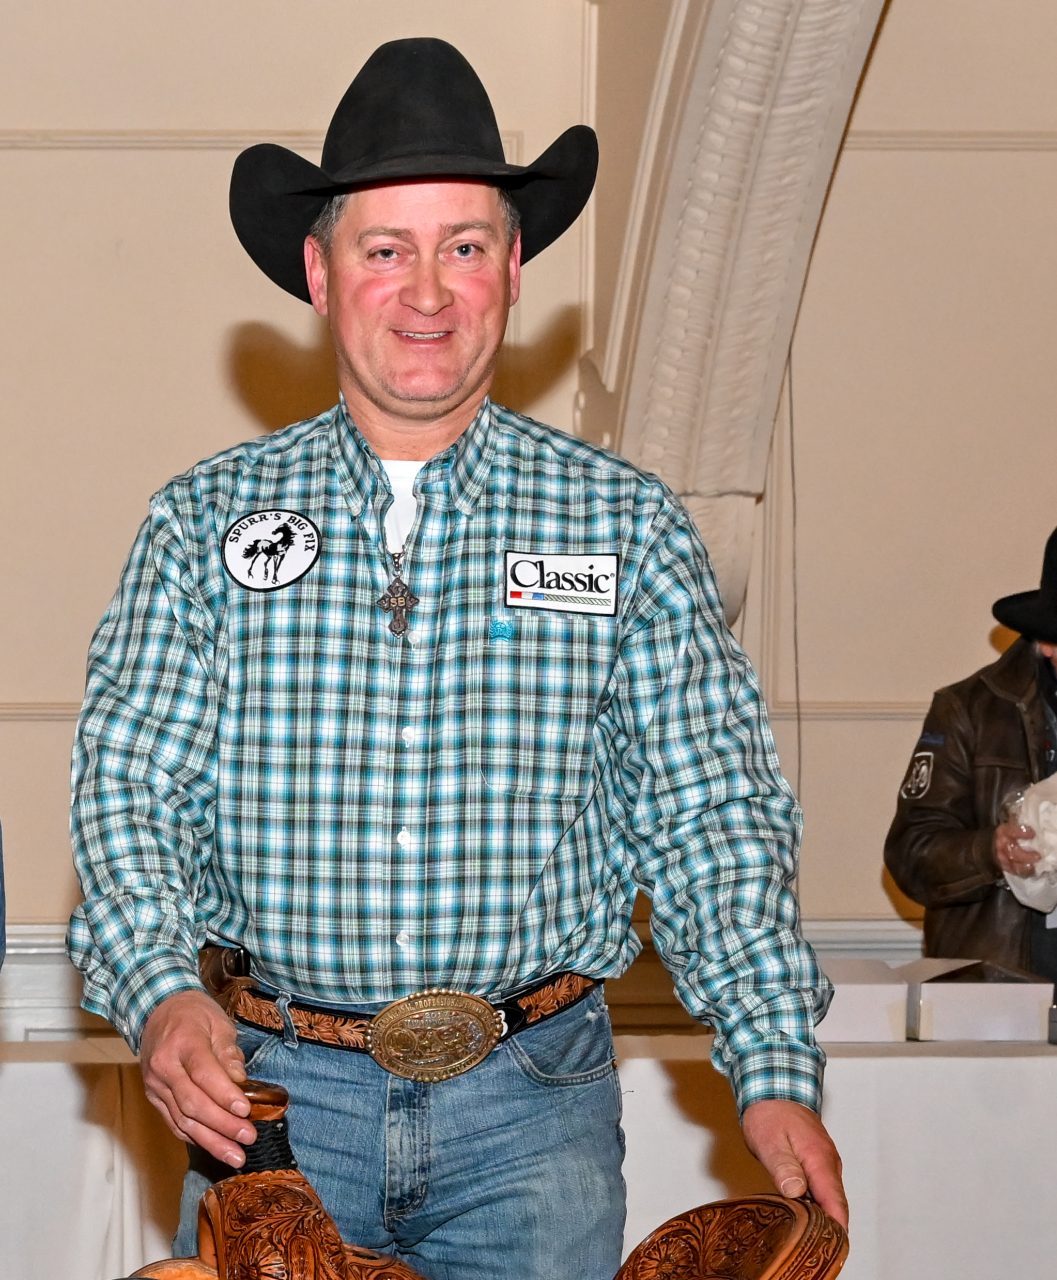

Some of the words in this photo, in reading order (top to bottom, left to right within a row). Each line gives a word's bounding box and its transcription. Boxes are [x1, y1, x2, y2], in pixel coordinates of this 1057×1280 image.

[229, 512, 282, 543] SPURR'S
[287, 515, 308, 531] BIG
[303, 532, 316, 552] FIX
[510, 560, 610, 593] Classic
